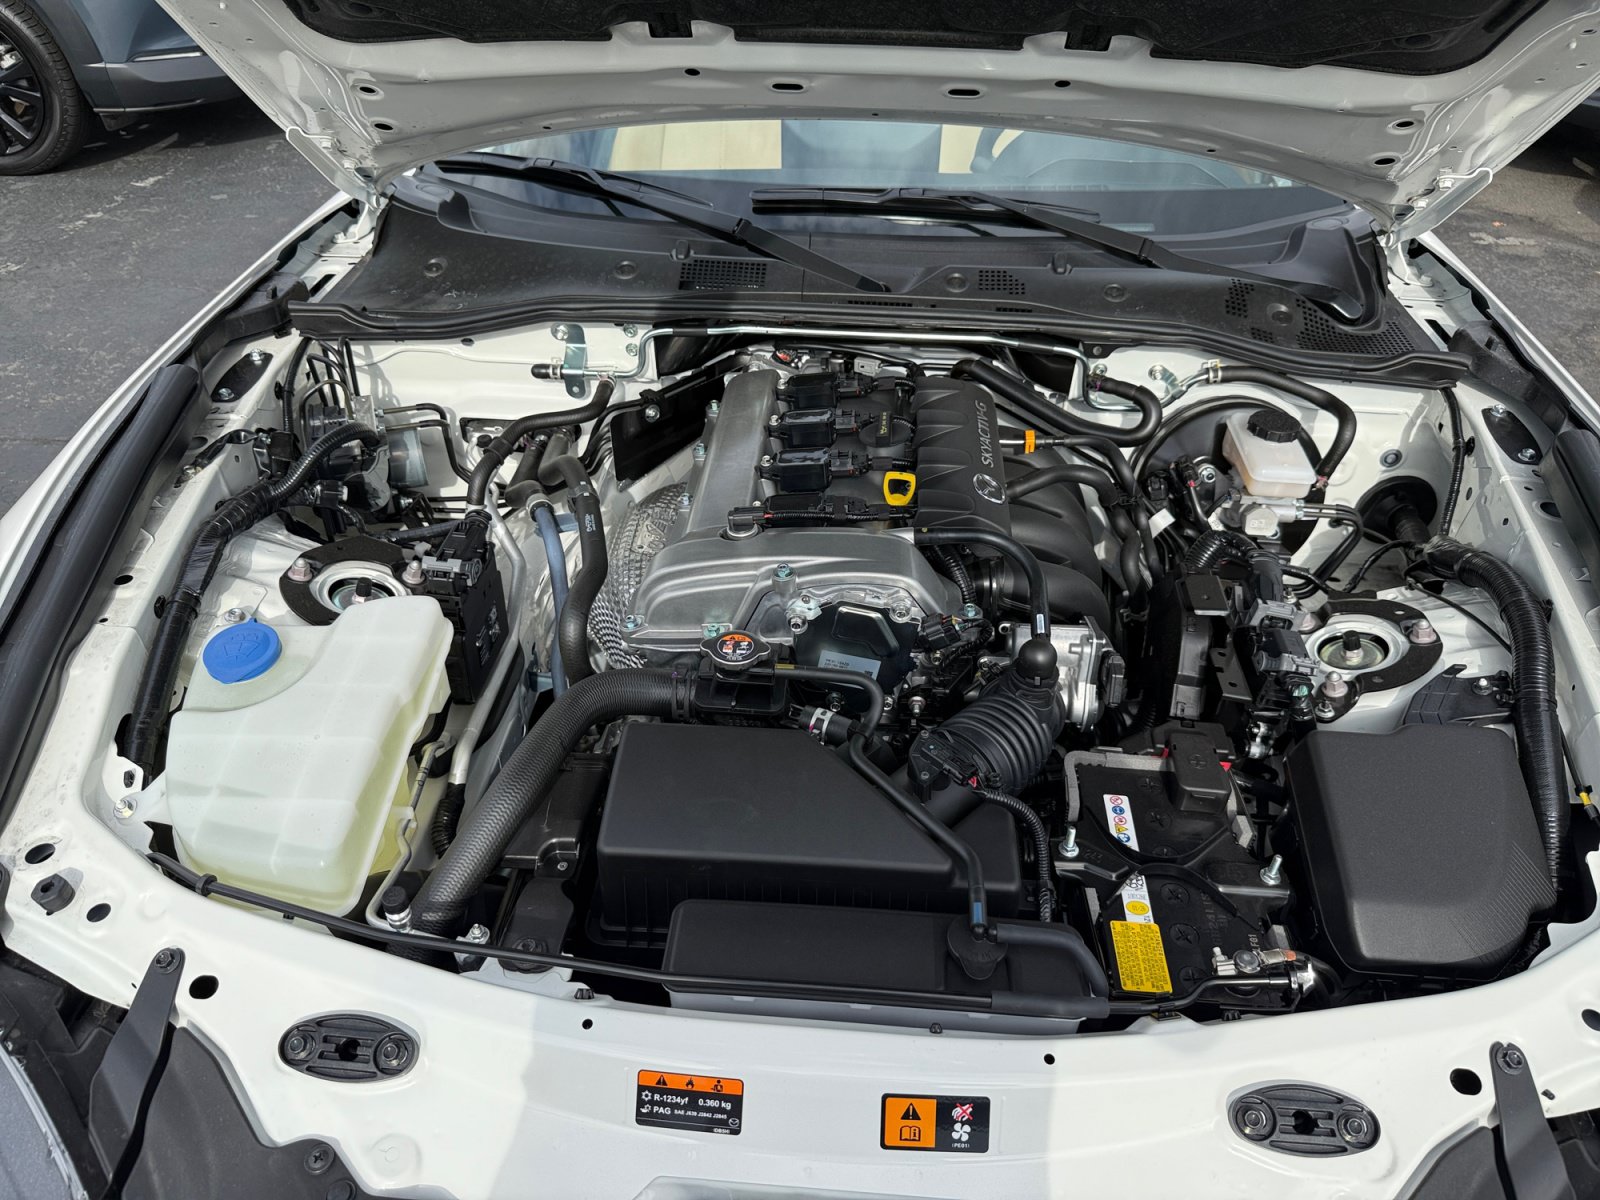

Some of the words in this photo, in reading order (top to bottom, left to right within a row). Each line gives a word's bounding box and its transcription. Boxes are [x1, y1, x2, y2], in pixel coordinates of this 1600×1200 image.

[974, 400, 994, 468] SKYACTIV-G
[653, 1093, 689, 1106] R-1234yf
[698, 1098, 720, 1108] 0.360
[721, 1100, 732, 1110] kg
[653, 1106, 671, 1115] PAG
